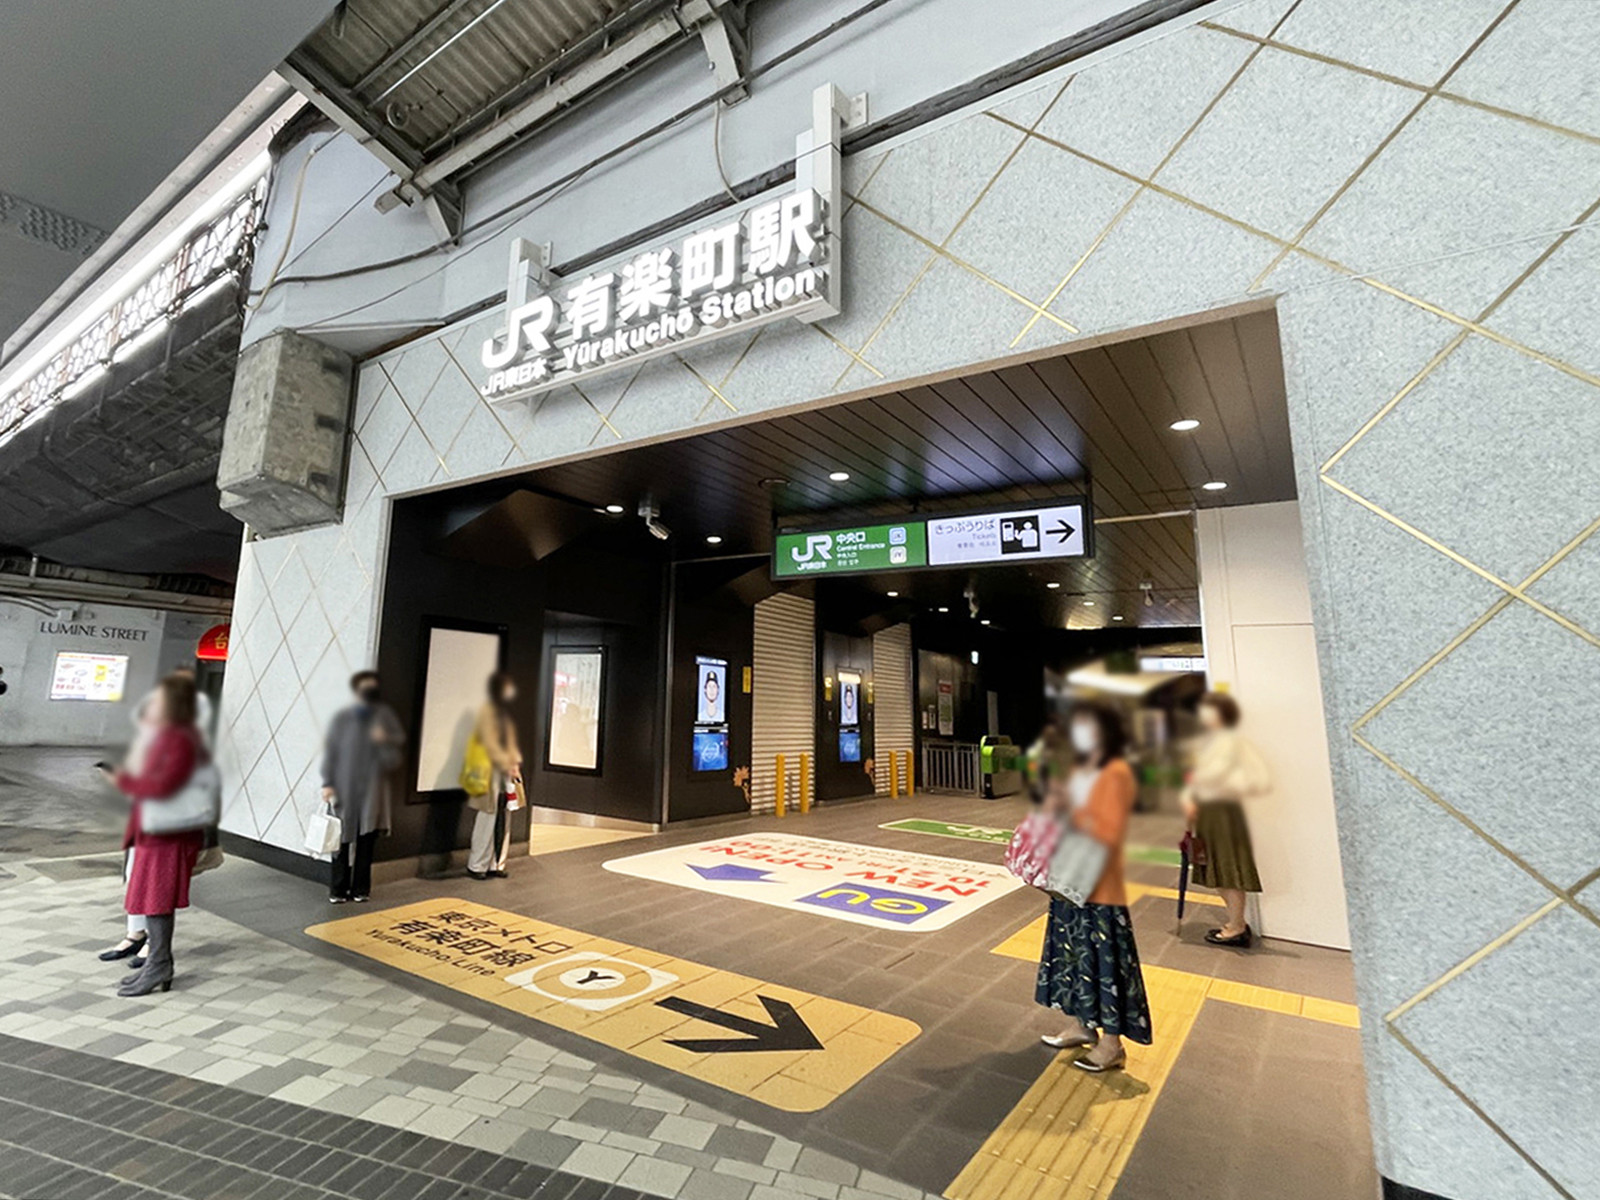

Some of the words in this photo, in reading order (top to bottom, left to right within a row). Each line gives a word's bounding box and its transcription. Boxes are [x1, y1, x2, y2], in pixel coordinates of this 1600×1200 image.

[481, 295, 554, 368] JR
[565, 188, 816, 341] 有楽町駅
[699, 269, 815, 325] Station
[792, 535, 832, 561] JR
[836, 532, 865, 544] 中央口
[40, 621, 97, 637] LUMINE
[101, 626, 149, 641] STREET
[844, 871, 980, 897] NEW
[816, 888, 929, 915] GU
[389, 920, 536, 967] 有楽町線
[428, 911, 573, 954] 東京メトロ
[452, 959, 495, 976] Line
[576, 970, 616, 985] Y
